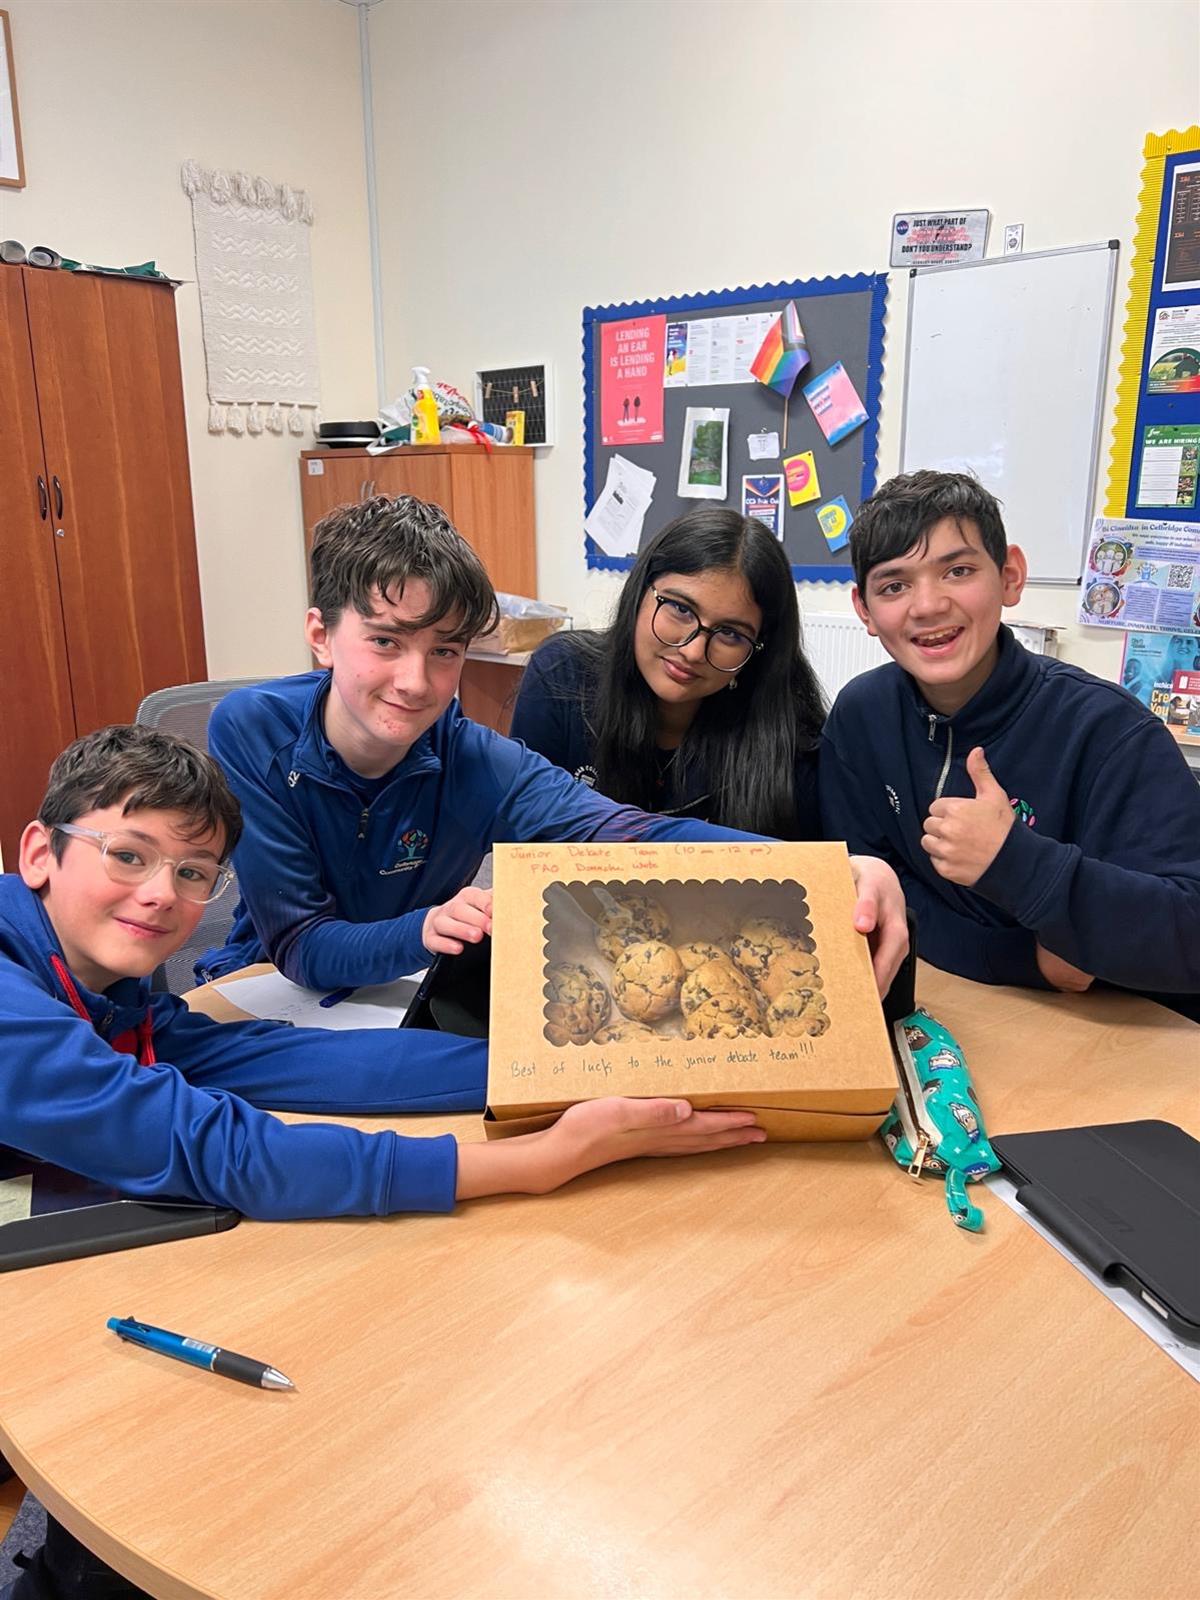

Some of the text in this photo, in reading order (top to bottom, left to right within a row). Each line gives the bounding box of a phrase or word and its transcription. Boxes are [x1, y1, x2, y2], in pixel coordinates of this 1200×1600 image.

[959, 217, 967, 225] OF
[918, 245, 930, 253] YOU
[931, 244, 972, 252] UNDERSTAND?
[615, 327, 650, 341] LENDING
[617, 340, 647, 353] AN EAR
[610, 352, 655, 367] IS LENDING
[616, 366, 648, 379] A HAND
[1152, 690, 1170, 703] Cre
[510, 847, 551, 859] Junior
[511, 1060, 536, 1078] Best
[553, 1060, 565, 1074] of
[582, 1059, 613, 1077] luck
[628, 1057, 640, 1070] to
[654, 1055, 673, 1068] the
[684, 1054, 717, 1070] junior
[727, 1048, 758, 1064] debate
